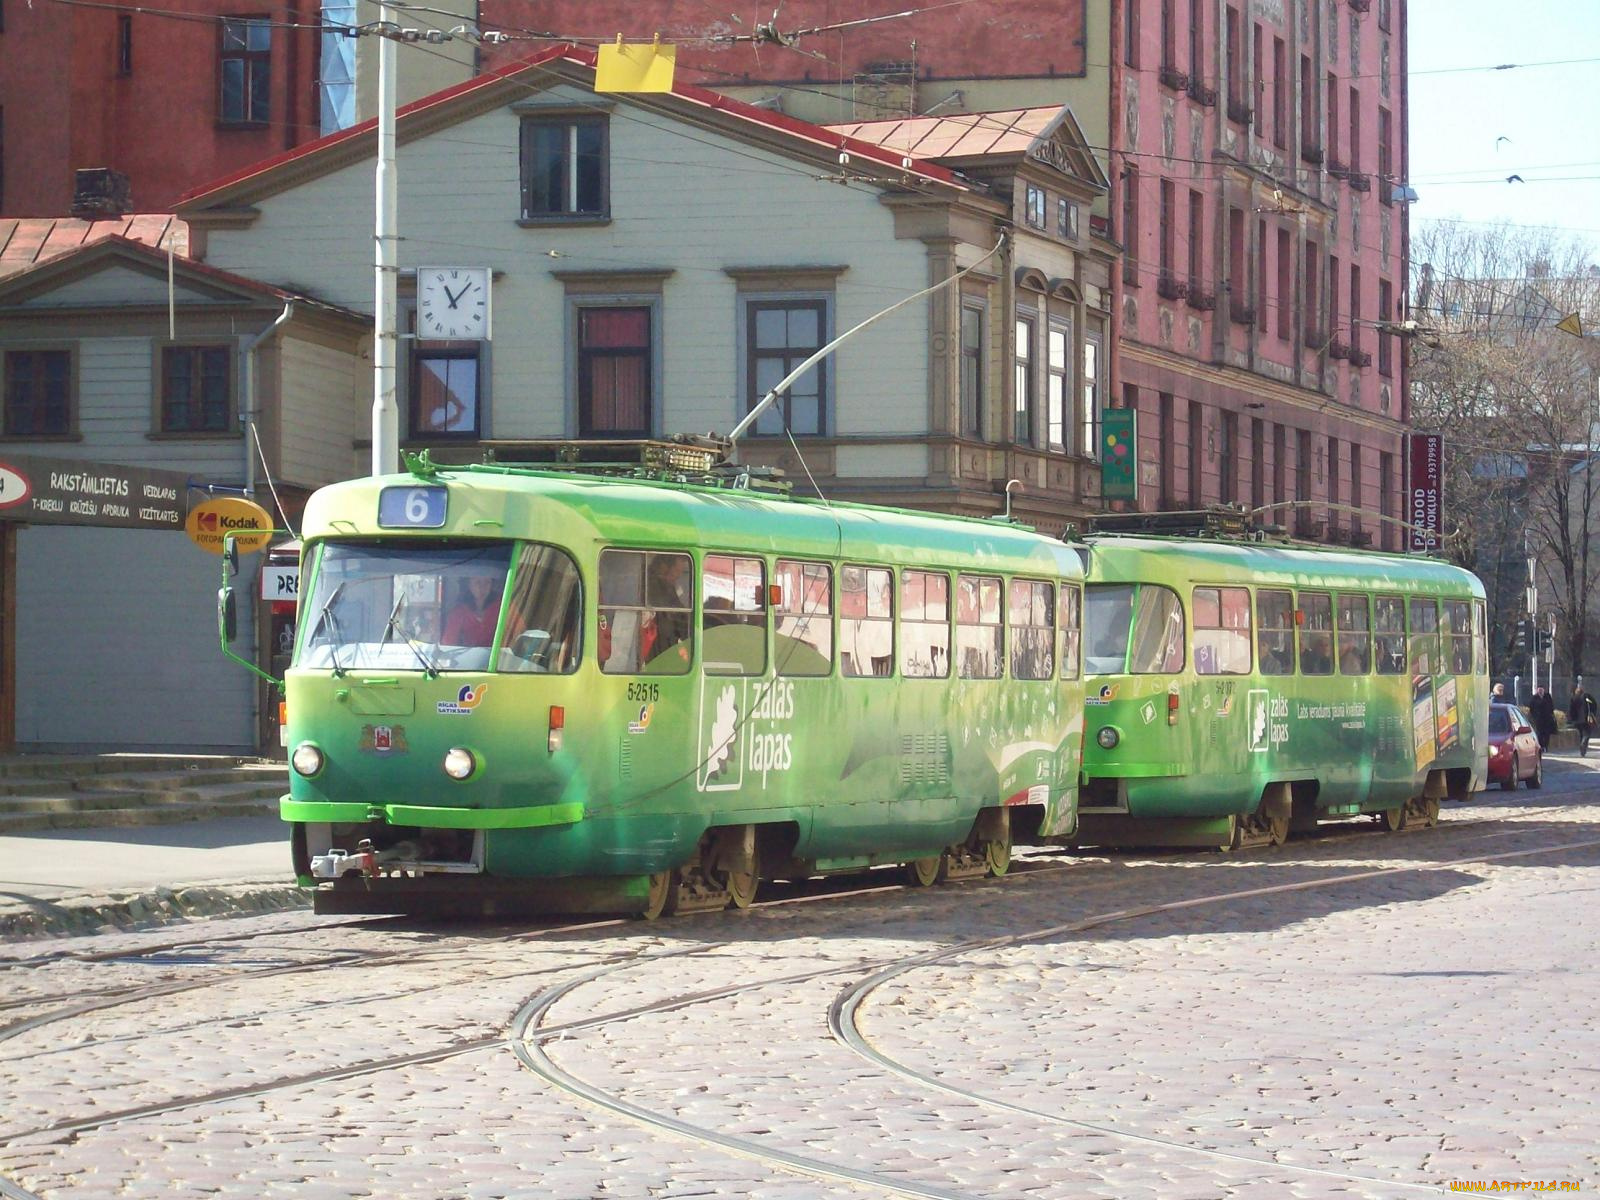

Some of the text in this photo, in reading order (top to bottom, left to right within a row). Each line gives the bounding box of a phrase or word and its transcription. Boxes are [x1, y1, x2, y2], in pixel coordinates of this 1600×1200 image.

[50, 472, 176, 500] RAKSTĀMLIETAS VEIDLAPAS
[101, 504, 130, 518] APDRUKA
[405, 489, 430, 523] 6
[220, 516, 259, 529] Kodak
[628, 682, 659, 702] 5-2515
[1270, 718, 1289, 752] lapas
[749, 721, 792, 790] lapas
